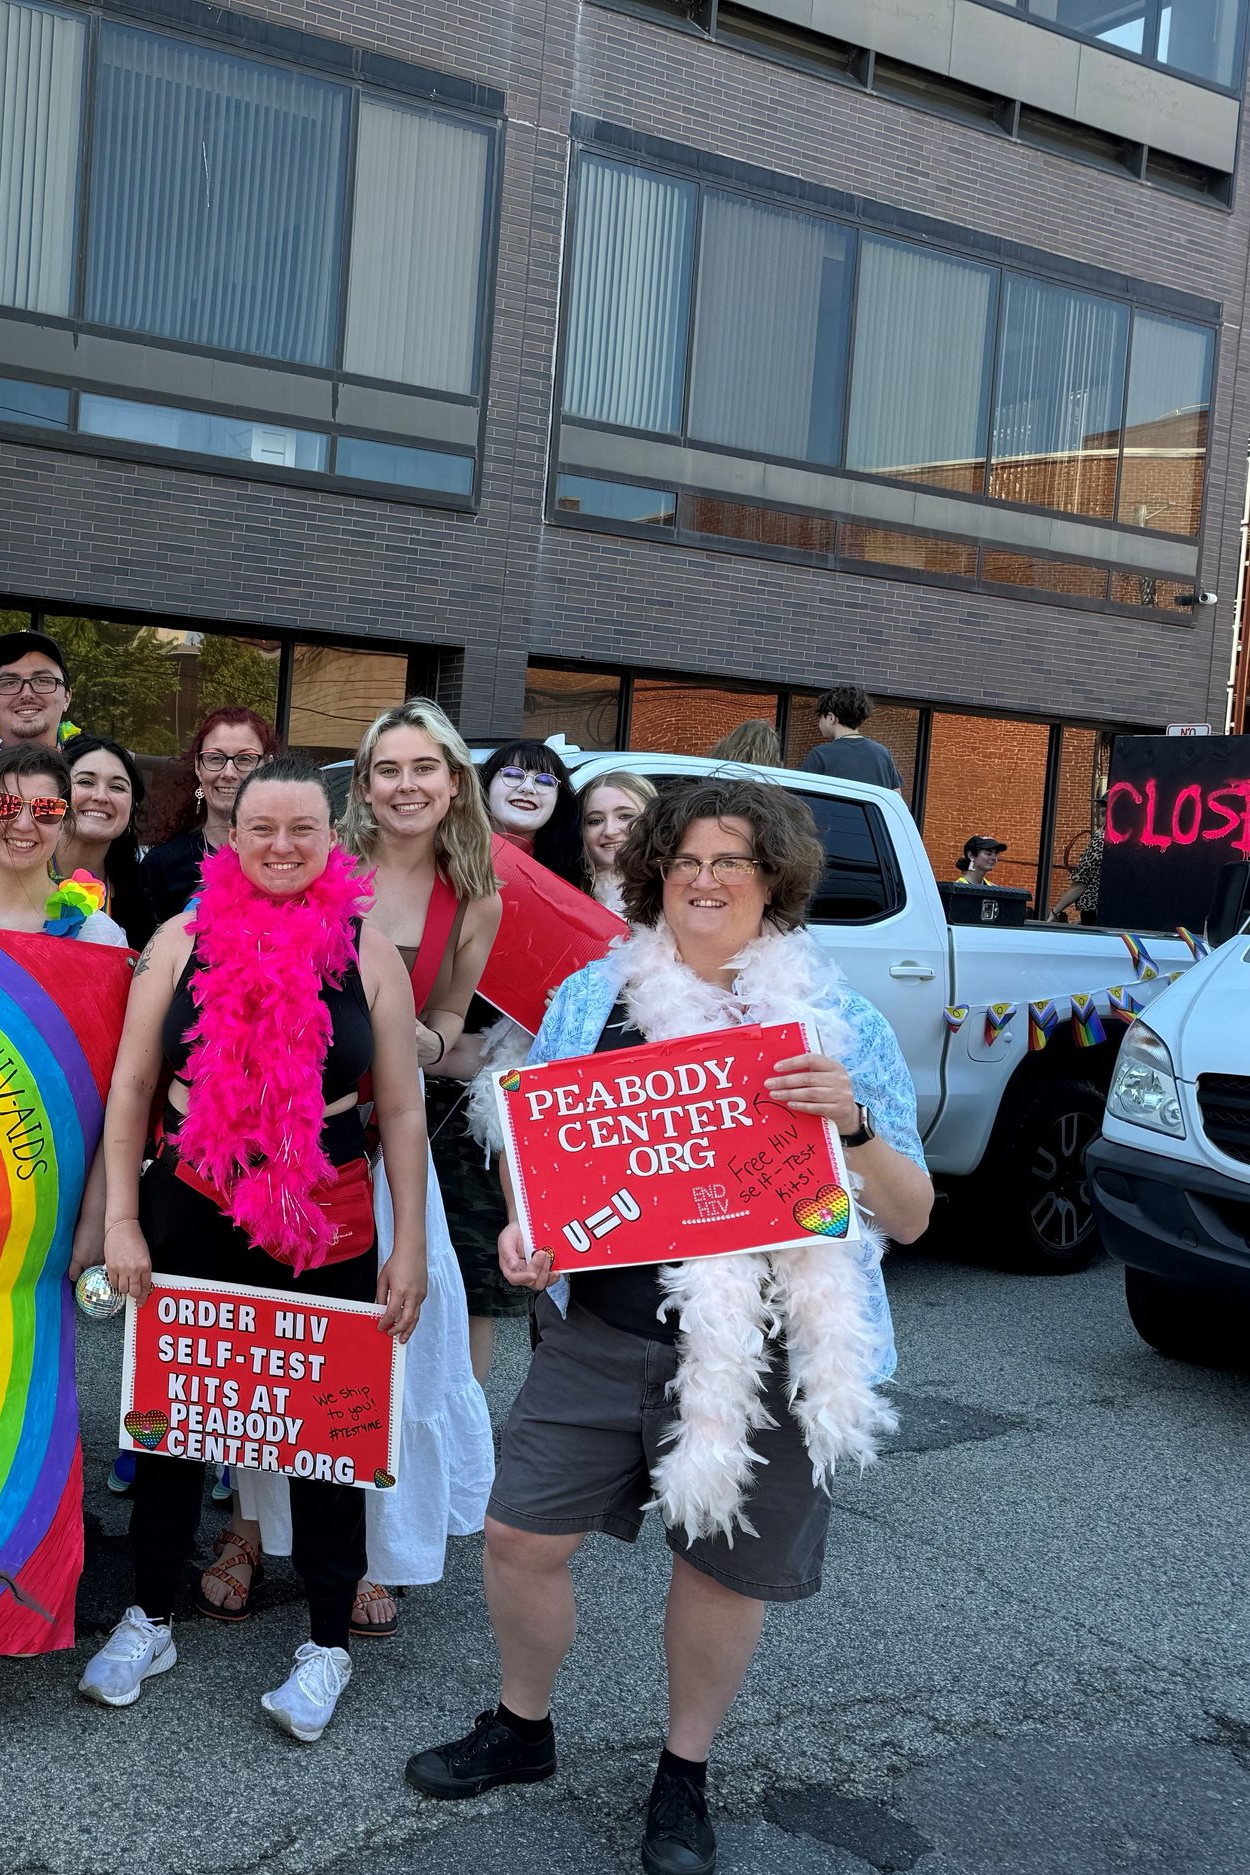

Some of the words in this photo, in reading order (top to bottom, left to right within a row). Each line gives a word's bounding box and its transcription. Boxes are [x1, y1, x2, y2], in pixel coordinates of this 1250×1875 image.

[524, 1055, 738, 1122] PEABODY
[557, 1095, 755, 1154] CENTER
[624, 1136, 717, 1178] .ORG
[727, 1151, 774, 1184] Free
[767, 1124, 799, 1154] HIV
[692, 1183, 726, 1203] END
[697, 1198, 729, 1217] HIV
[561, 1186, 643, 1254] U=U
[157, 1296, 257, 1333] ORDER
[274, 1309, 329, 1344] HIV
[157, 1334, 326, 1383] SELF-TEST
[167, 1372, 240, 1409] KITS
[250, 1384, 291, 1415] AT
[312, 1393, 338, 1407] We
[327, 1408, 344, 1420] to
[347, 1397, 378, 1422] you!
[169, 1401, 305, 1445] PEABODY
[329, 1418, 383, 1442] #TEST4ME
[166, 1429, 356, 1484] CENTER.ORG
